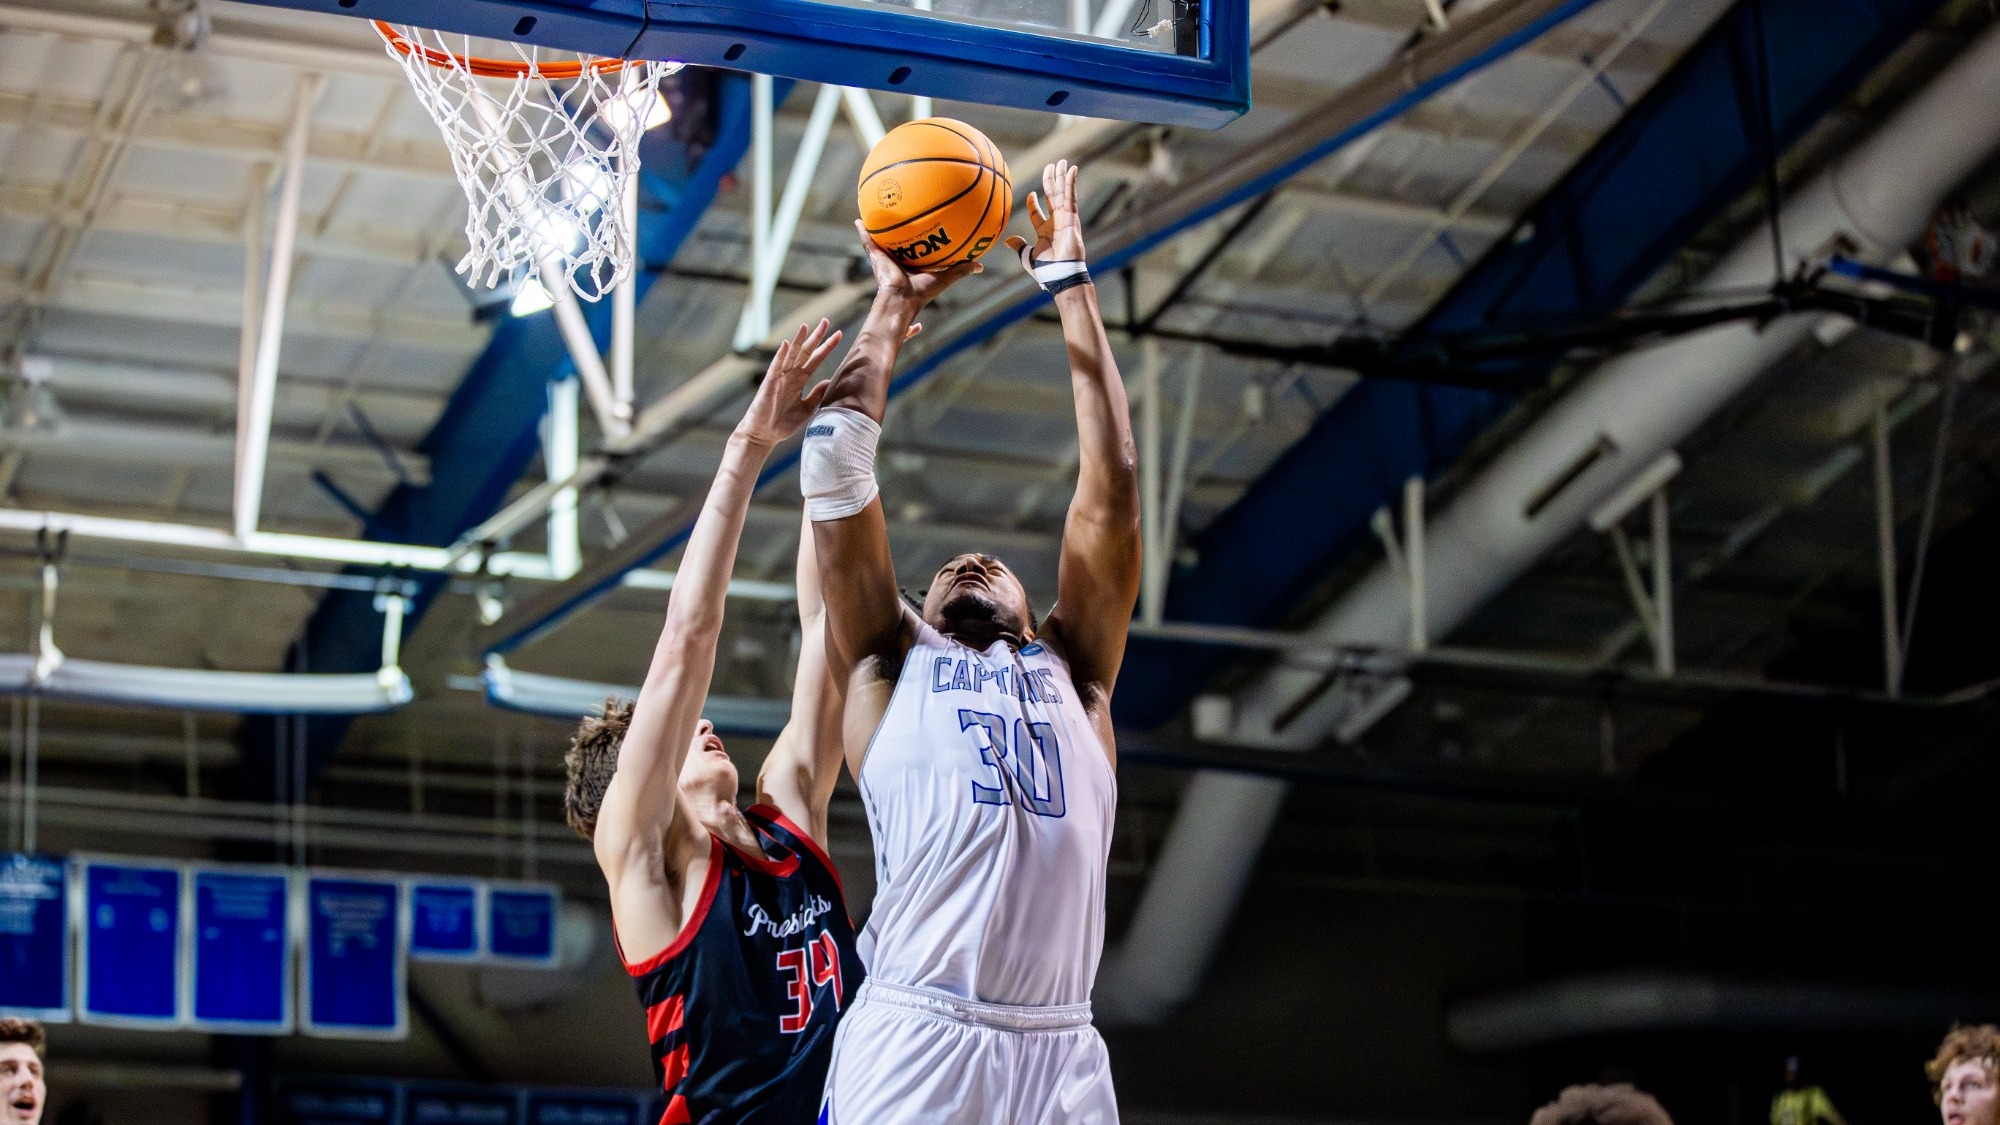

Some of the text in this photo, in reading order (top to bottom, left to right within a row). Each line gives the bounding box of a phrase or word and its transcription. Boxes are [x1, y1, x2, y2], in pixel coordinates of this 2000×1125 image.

[886, 226, 952, 261] NCAA
[957, 708, 1066, 818] 30
[776, 928, 844, 1034] 34
